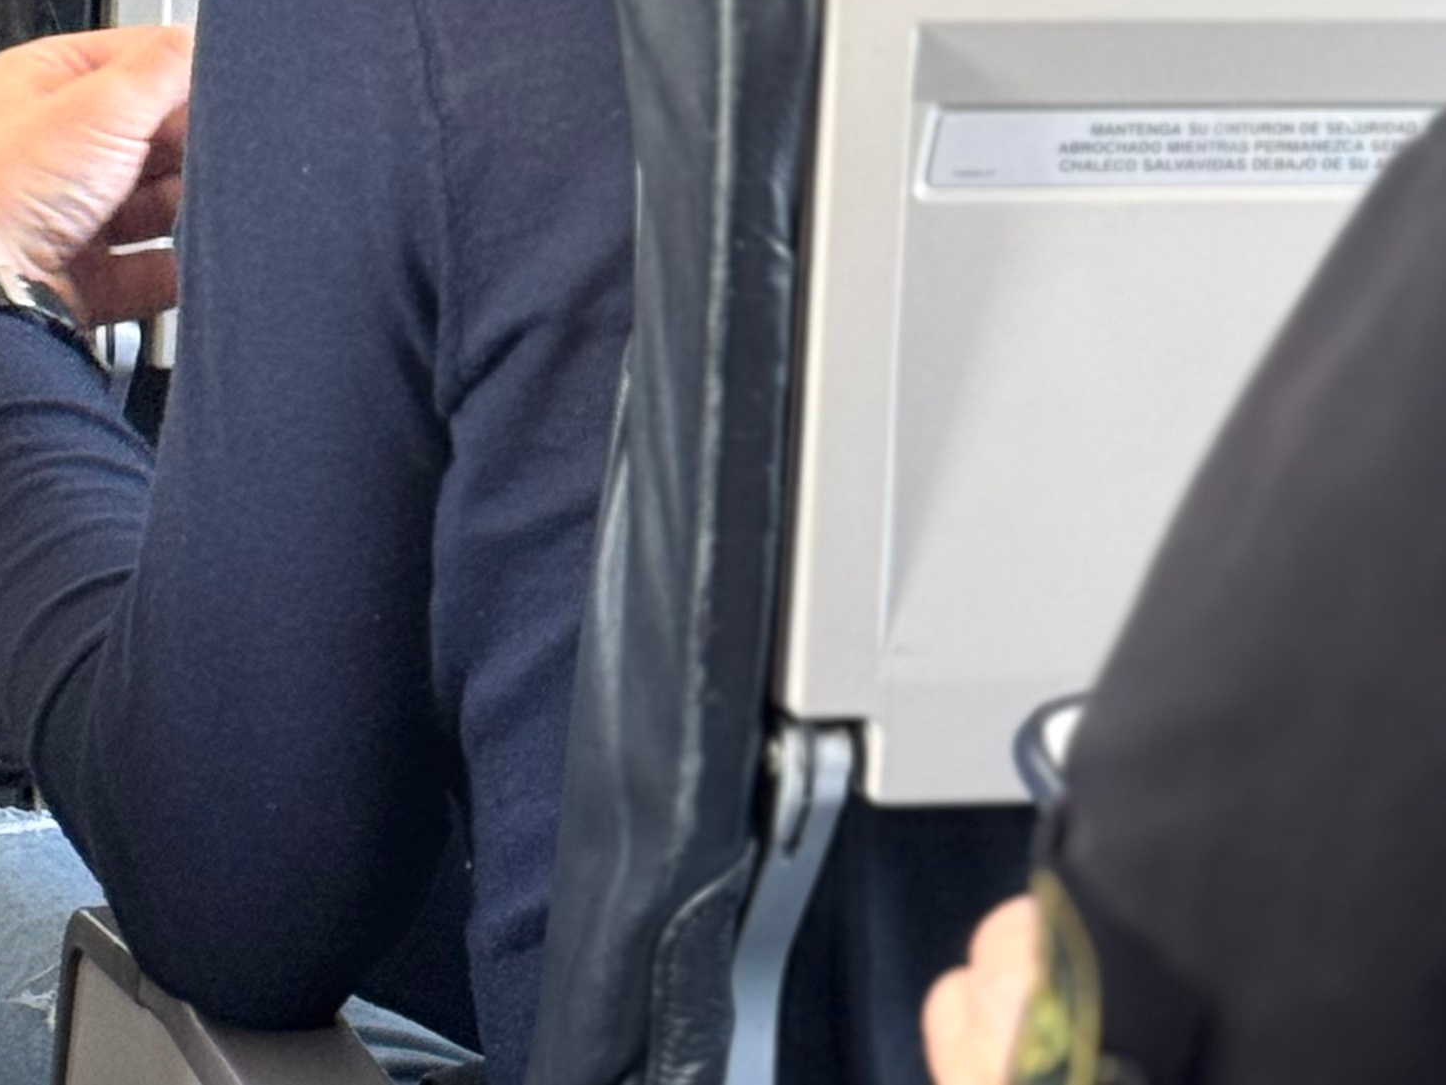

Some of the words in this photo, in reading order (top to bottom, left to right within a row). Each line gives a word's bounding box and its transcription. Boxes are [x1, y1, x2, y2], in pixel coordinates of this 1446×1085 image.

[1090, 123, 1181, 137] MANTENGA
[1188, 122, 1209, 136] SU
[1299, 122, 1320, 135] DE
[1058, 141, 1162, 155] ABROCHADO
[1167, 141, 1249, 154] MIENTRAS
[1254, 140, 1364, 153] PERMANEZCA
[1058, 159, 1137, 173] CHALECO
[1143, 159, 1246, 172] SALVAVIDAS
[1252, 157, 1317, 171] DEBAJO
[1321, 157, 1343, 170] DE
[1347, 157, 1369, 170] SU
